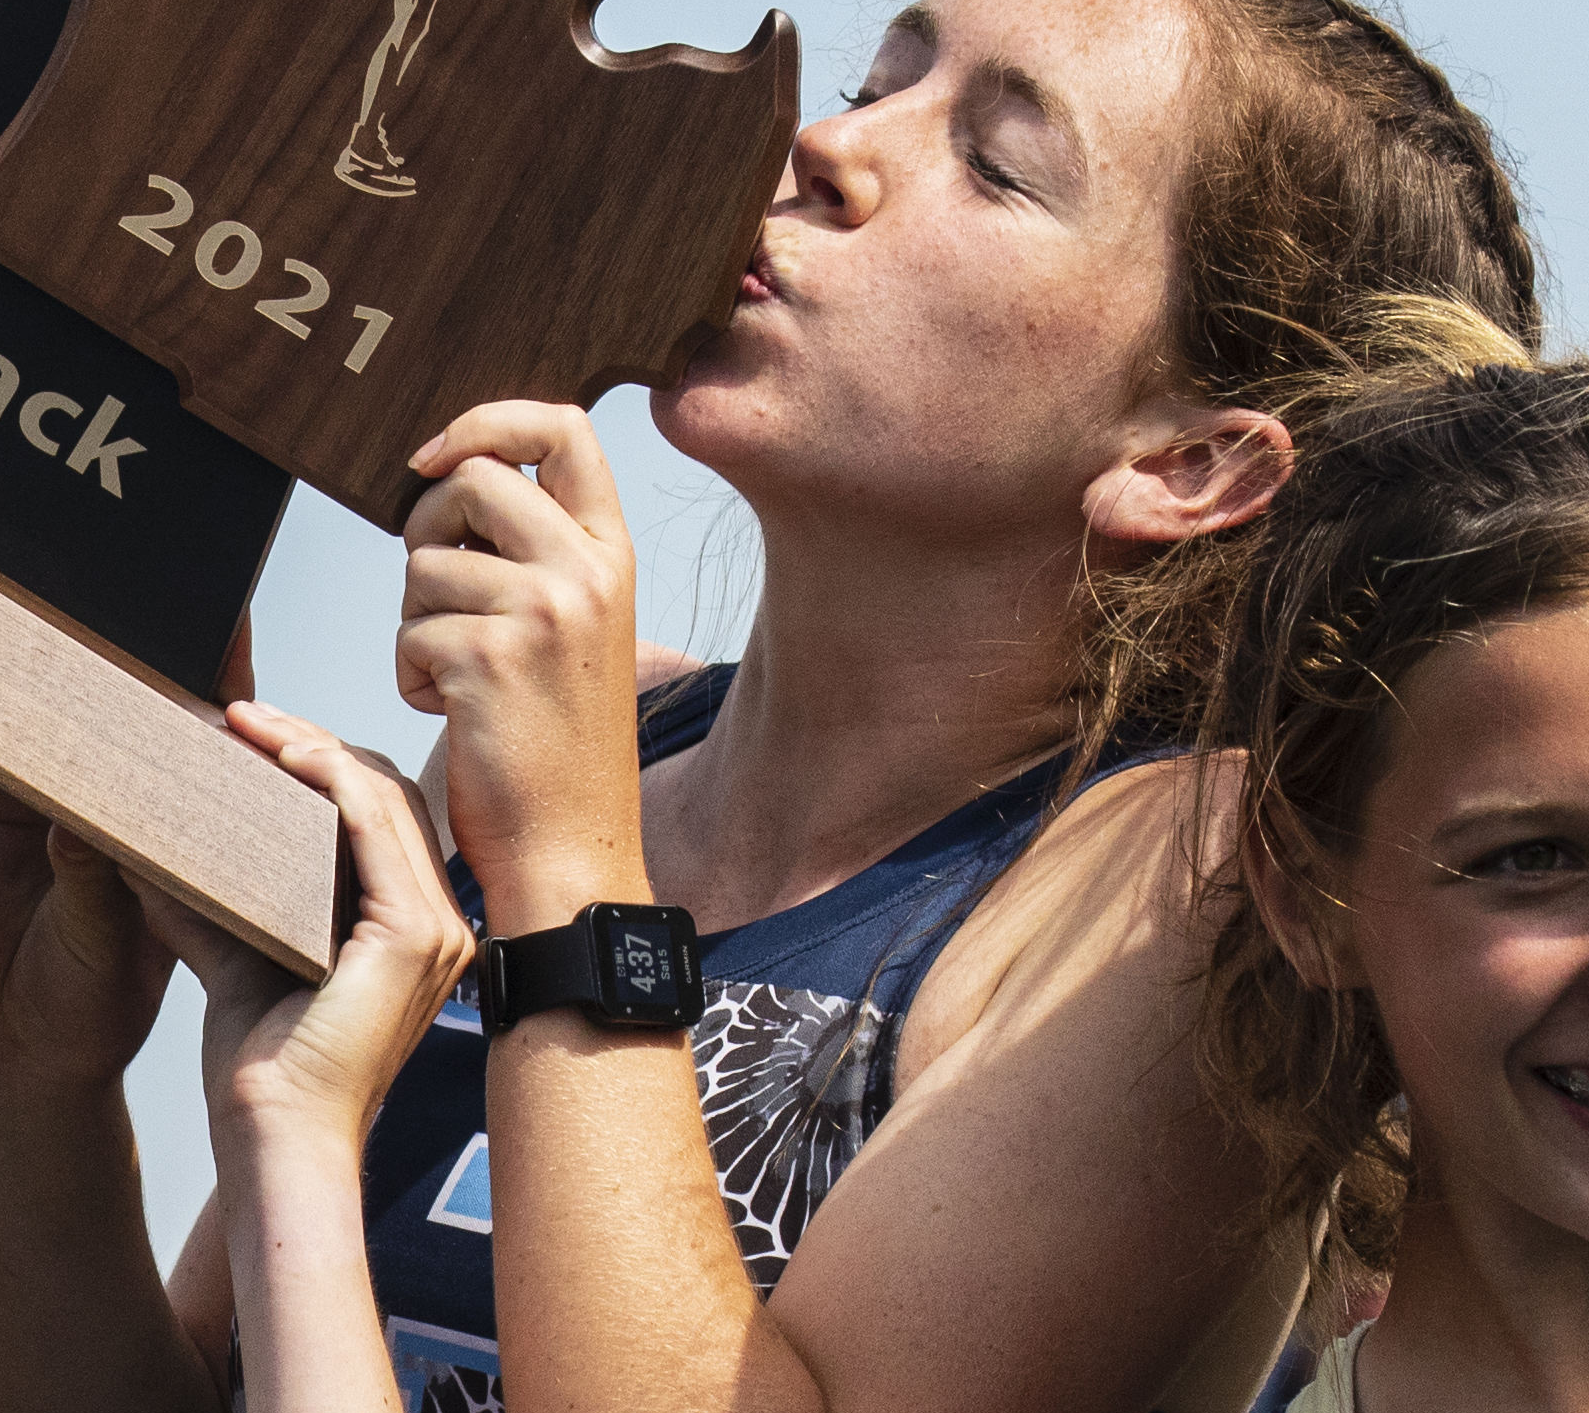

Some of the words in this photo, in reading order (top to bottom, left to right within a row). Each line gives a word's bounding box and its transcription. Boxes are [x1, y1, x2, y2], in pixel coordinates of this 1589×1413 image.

[118, 174, 393, 374] 2021
[625, 933, 656, 994] 4:37
[658, 949, 668, 957] 5
[660, 958, 671, 980] Sat
[682, 945, 692, 984] GARMIN
